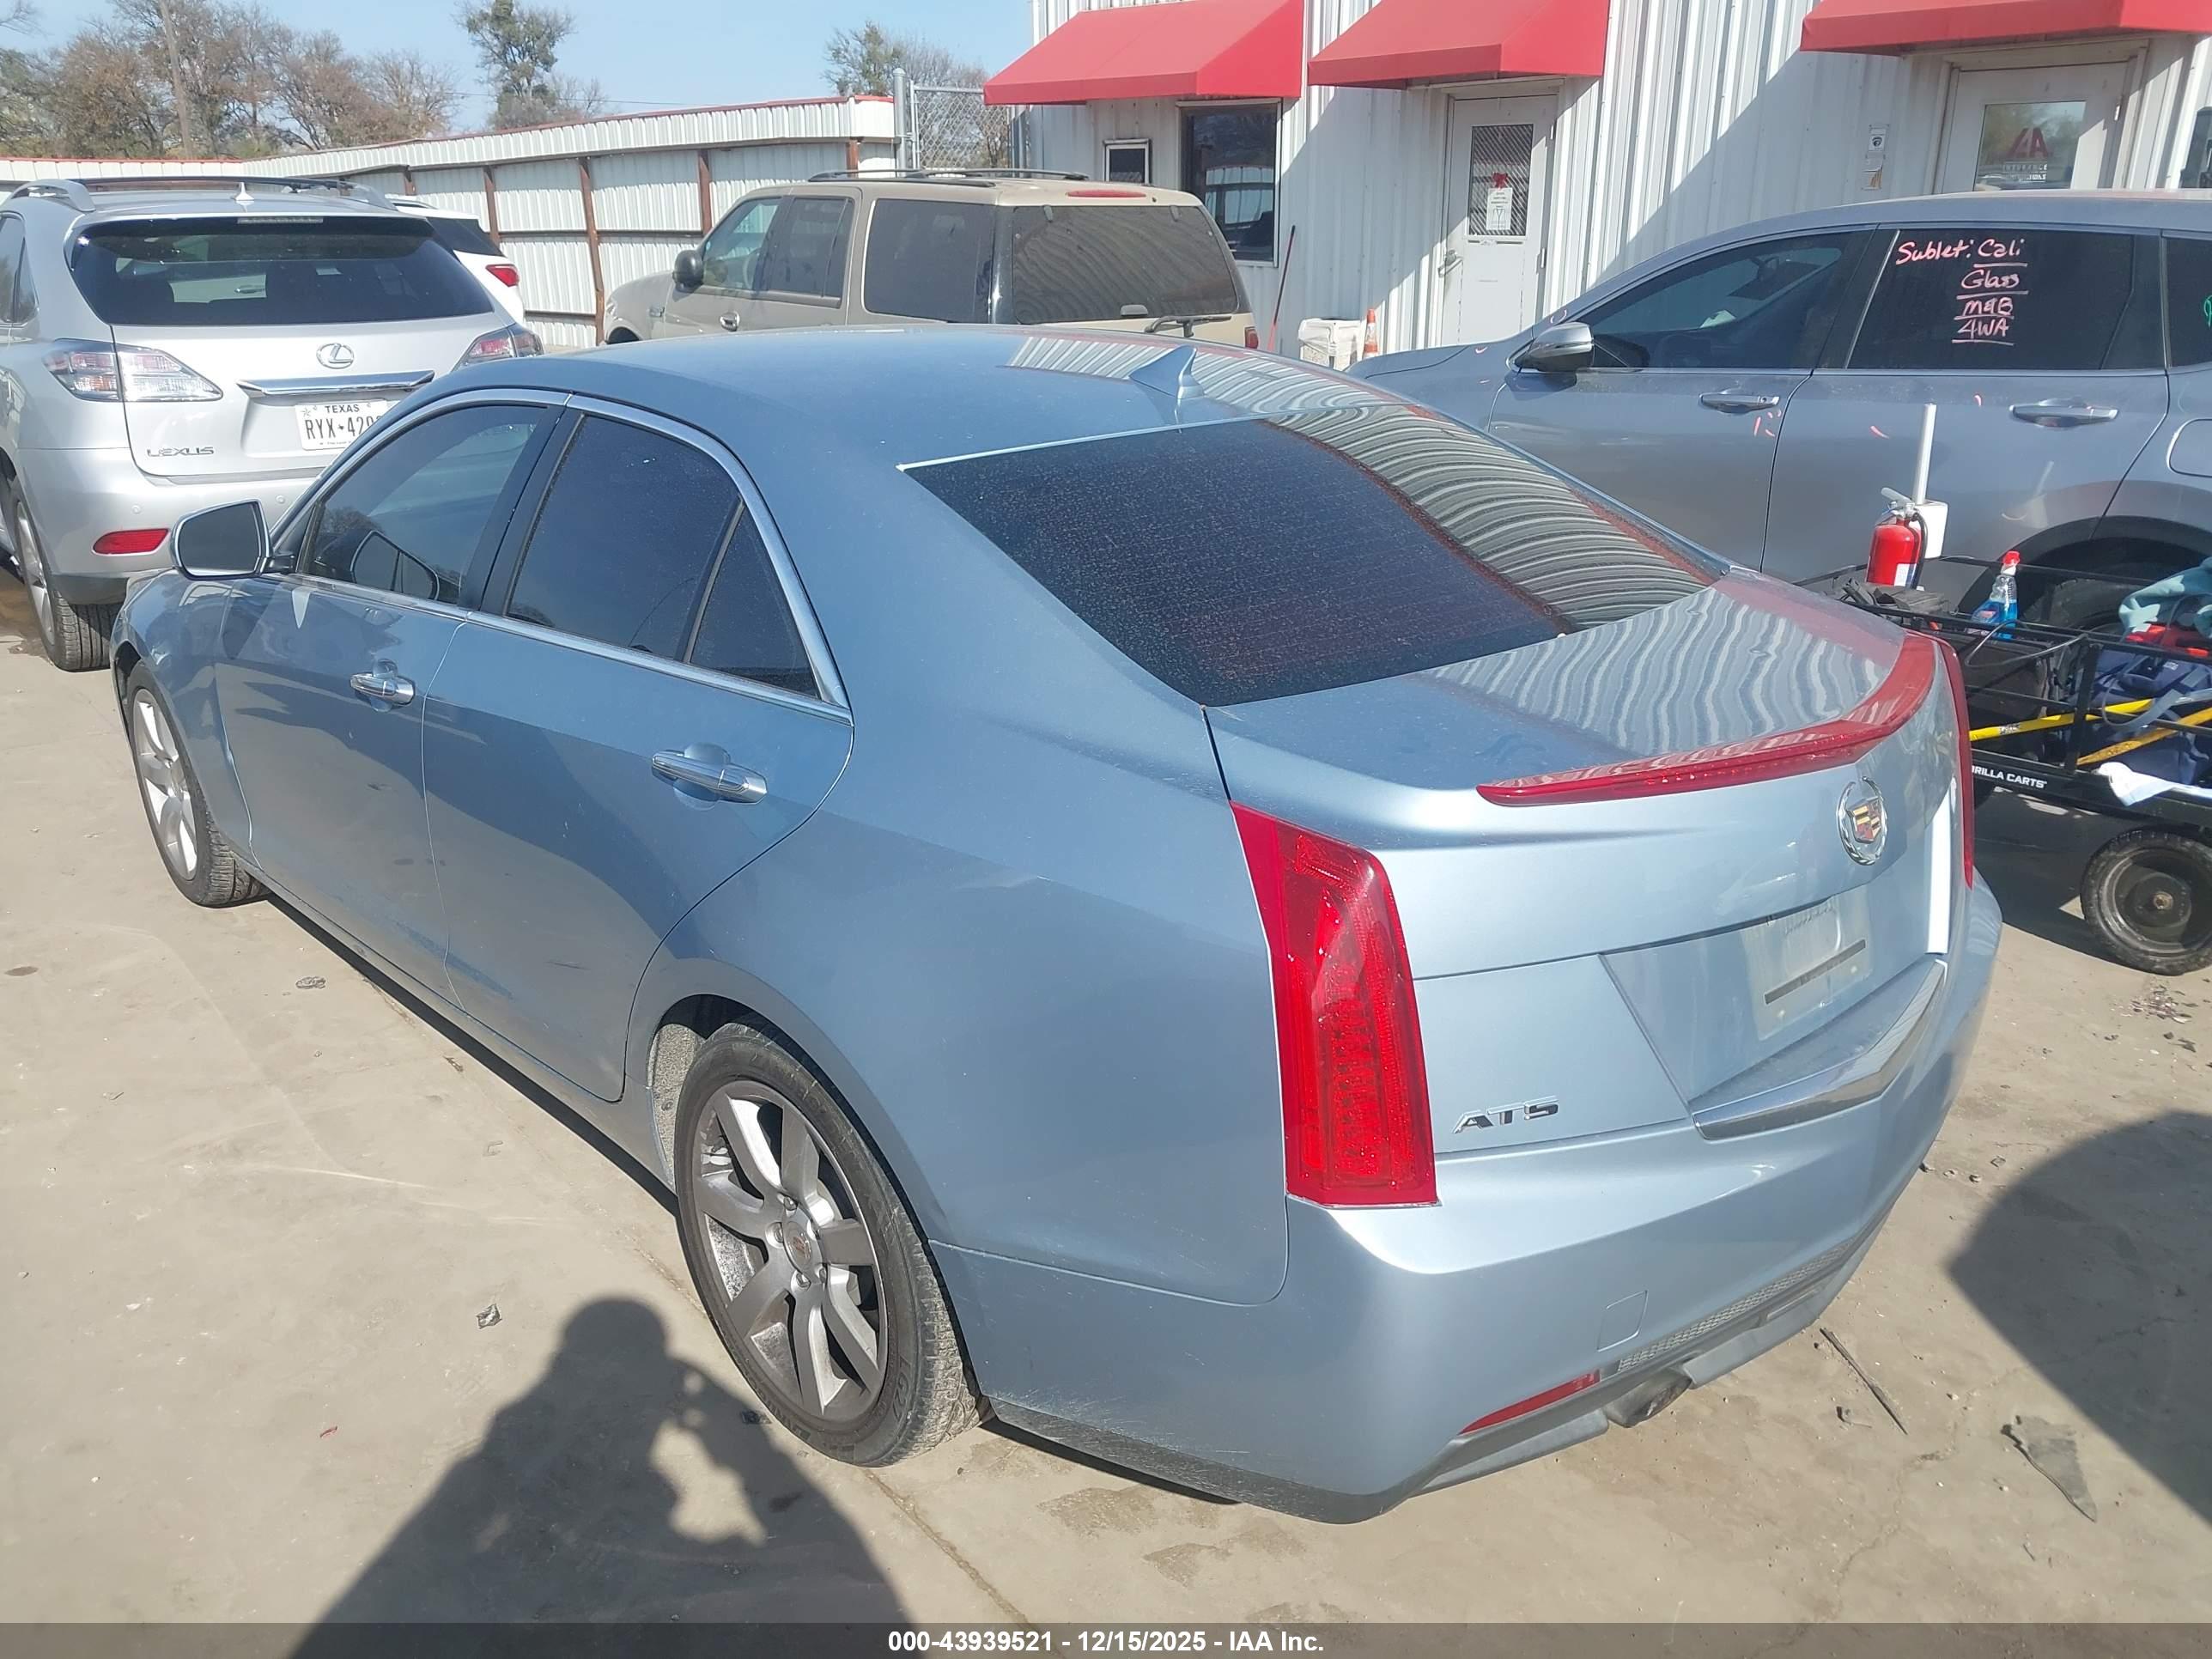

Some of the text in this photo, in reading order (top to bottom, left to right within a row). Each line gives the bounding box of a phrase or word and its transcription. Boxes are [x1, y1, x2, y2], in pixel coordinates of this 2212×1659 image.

[1978, 239, 2025, 258] Cali
[1961, 270, 2020, 289] Glass
[1958, 318, 2009, 339] 4WA
[325, 404, 360, 413] TEXAS
[147, 446, 215, 458] LEXUS
[1451, 1096, 1559, 1133] ATS
